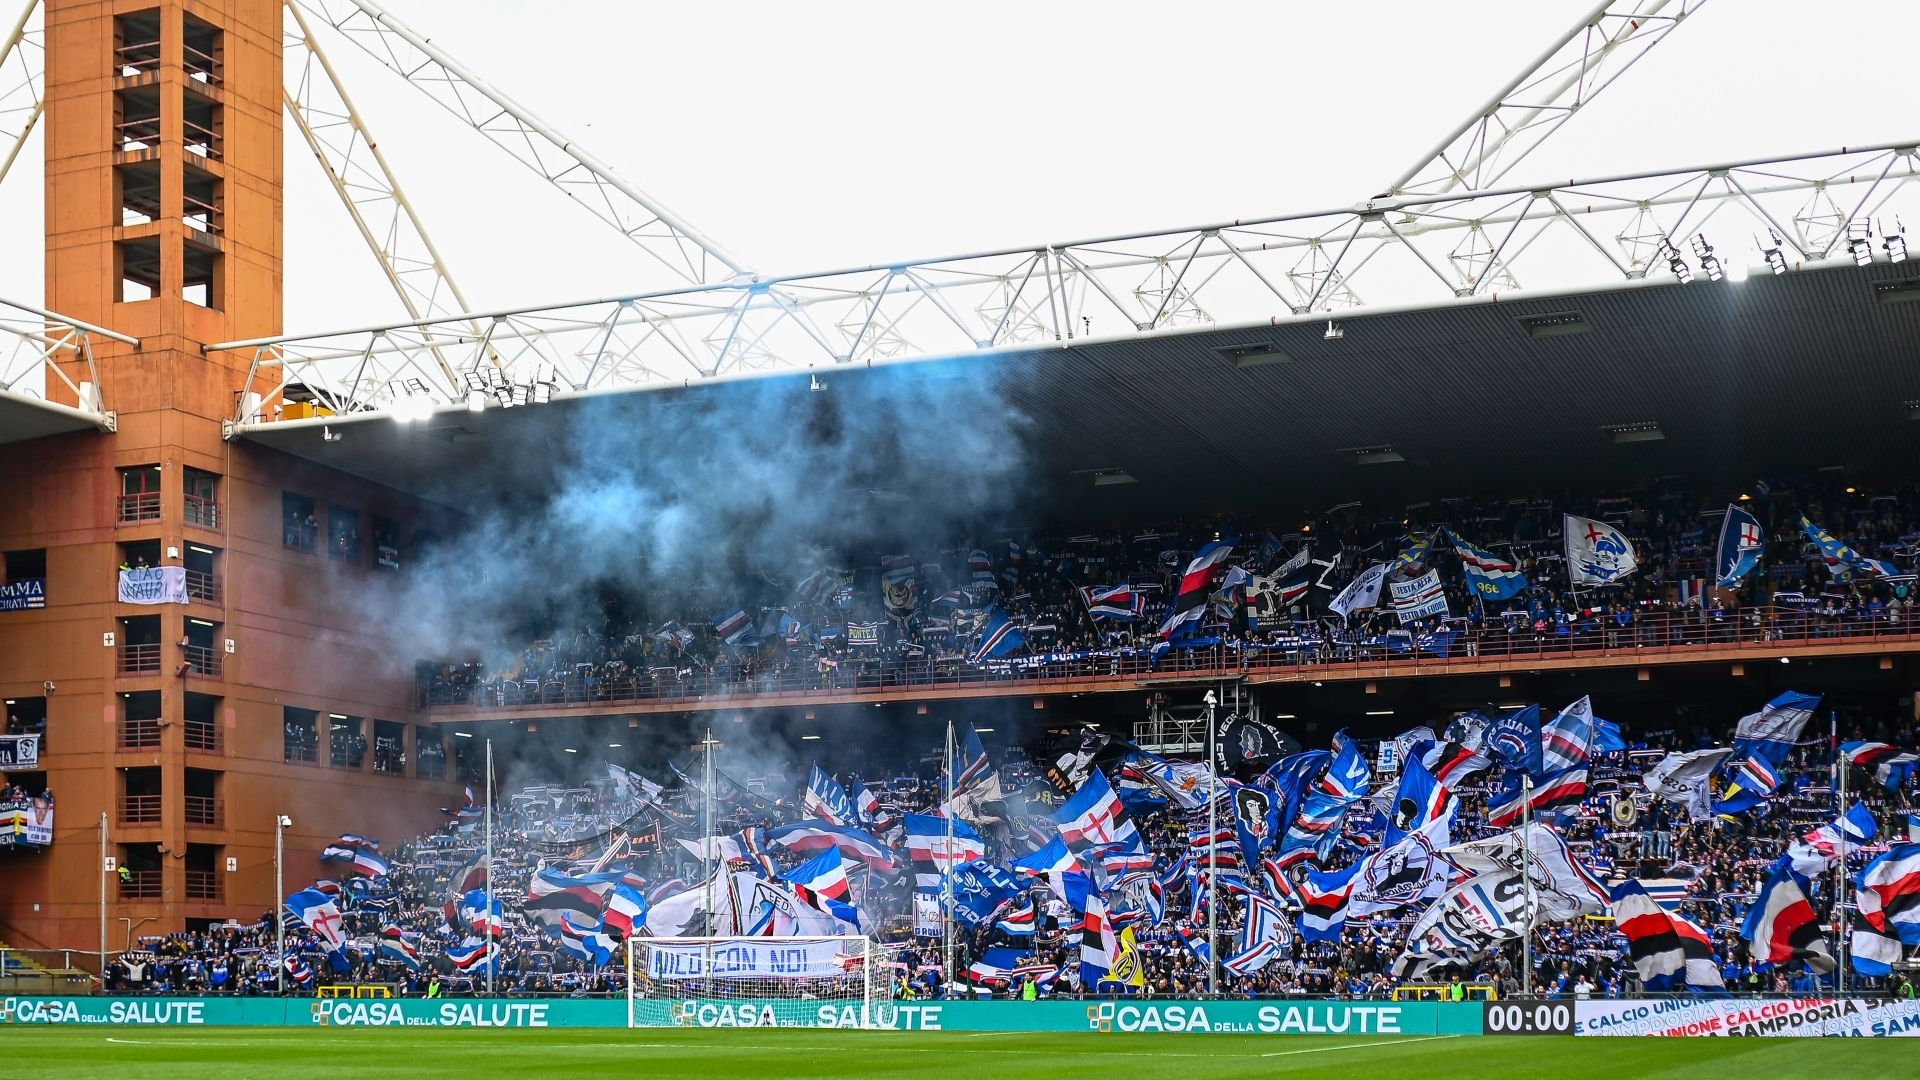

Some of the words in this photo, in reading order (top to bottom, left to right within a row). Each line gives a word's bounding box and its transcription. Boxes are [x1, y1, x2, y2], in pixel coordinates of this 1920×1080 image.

[127, 568, 163, 581] CIAO
[1396, 583, 1416, 594] TESTA
[655, 950, 701, 975] NICO
[770, 949, 807, 973] NOI
[17, 1001, 80, 1022] CASA
[81, 1014, 108, 1023] DELLA
[110, 1002, 204, 1024] SALUTE
[333, 1003, 405, 1026] CASA
[407, 1017, 437, 1026] DELLA
[440, 1003, 549, 1027] SALUTE
[698, 1004, 777, 1027] CASA
[780, 1019, 817, 1027] DELLA
[818, 1005, 943, 1030] SALUTE
[1117, 1006, 1210, 1032] CASA
[1214, 1022, 1254, 1032] DELLA
[1258, 1006, 1402, 1033] SALUTE
[1489, 1005, 1570, 1031] 00:00
[1588, 1006, 1649, 1030] CALCIO
[1726, 1003, 1788, 1026] CALCIO
[1728, 999, 1859, 1037] SAMPDORIA
